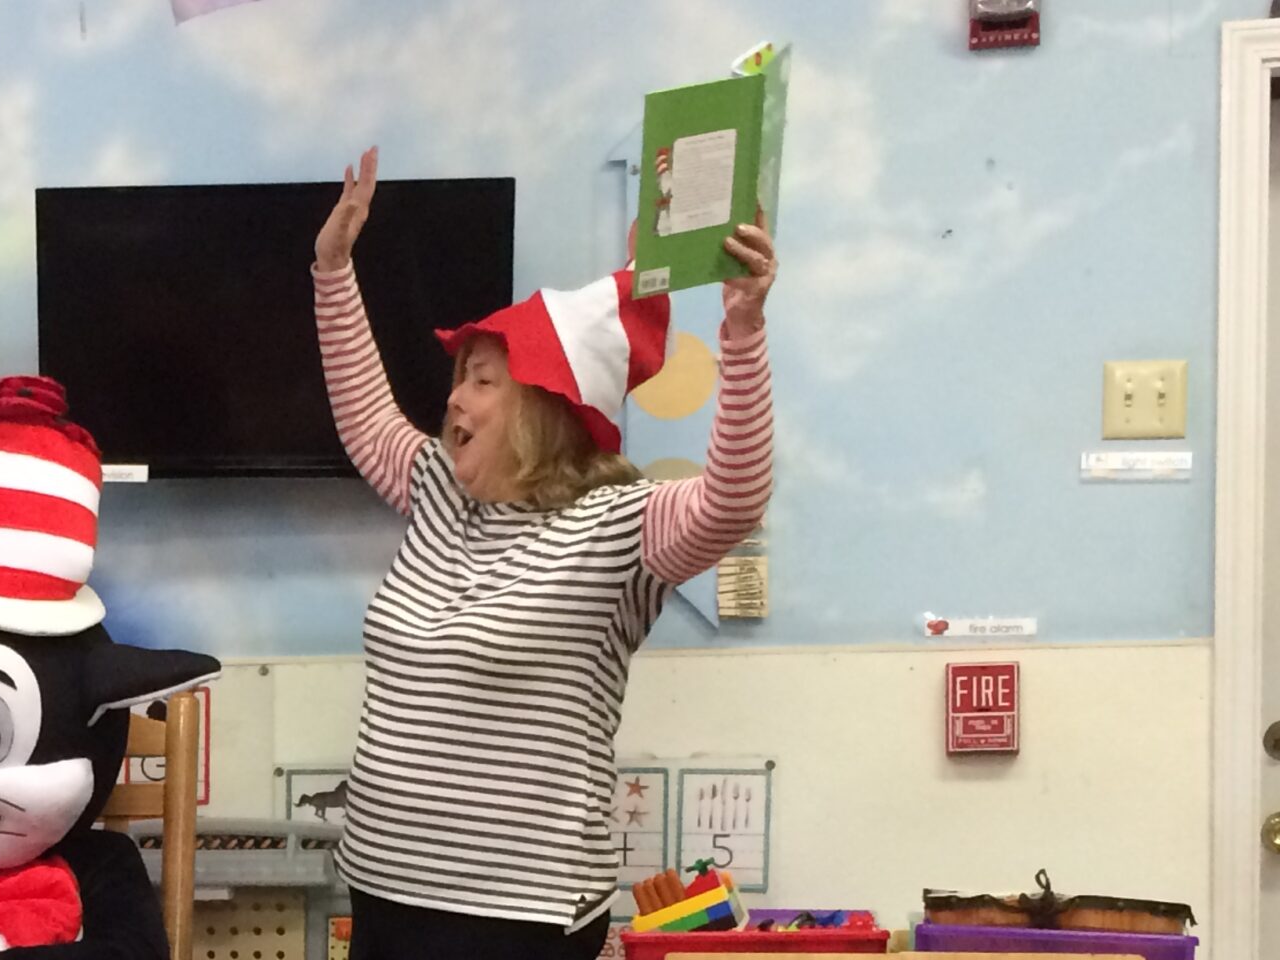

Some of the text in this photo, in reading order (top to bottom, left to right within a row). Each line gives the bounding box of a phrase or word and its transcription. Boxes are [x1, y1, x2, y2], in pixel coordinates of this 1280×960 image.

[968, 624, 1023, 633] fire alarm
[956, 675, 1011, 707] FIRE
[712, 834, 733, 868] 5
